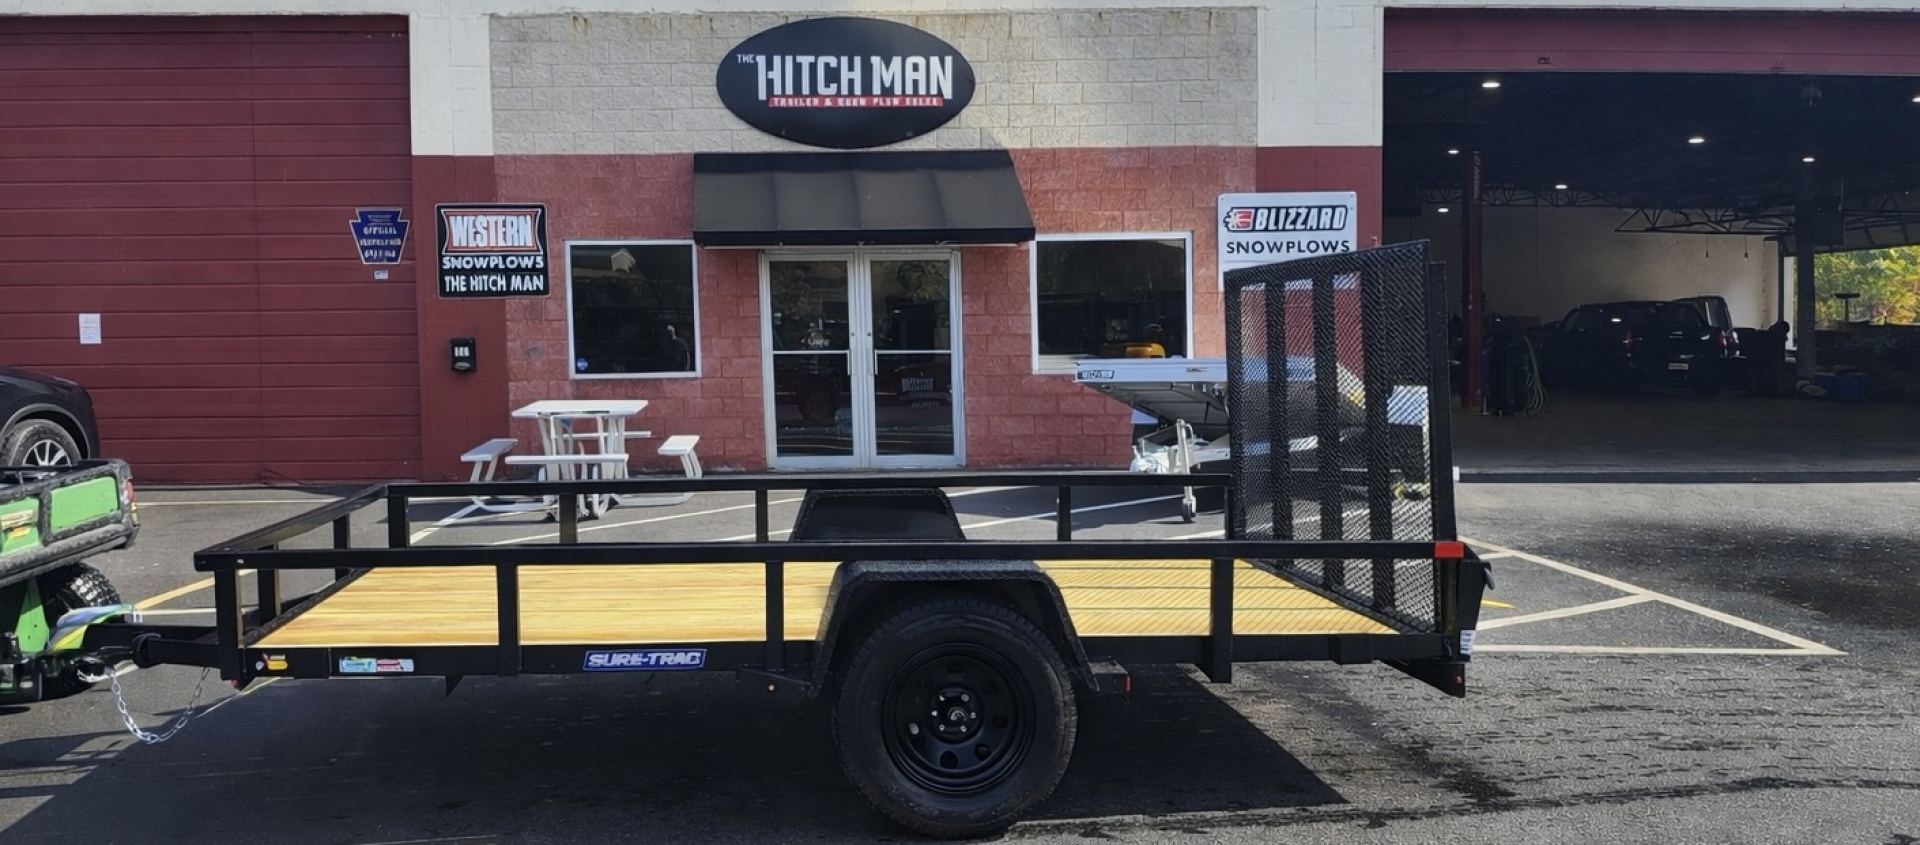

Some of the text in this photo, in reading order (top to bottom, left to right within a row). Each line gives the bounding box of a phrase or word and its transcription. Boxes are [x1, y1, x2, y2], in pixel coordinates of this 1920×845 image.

[736, 54, 953, 100] THE HITCH MAN
[1255, 206, 1347, 231] BLIZZARD
[449, 215, 532, 247] WESTERN
[1226, 240, 1350, 254] SNOWPLOWS
[442, 256, 544, 269] SNOWPLOWS
[444, 274, 544, 292] THE HITCH MAN
[588, 652, 702, 667] SURE-TRAC
